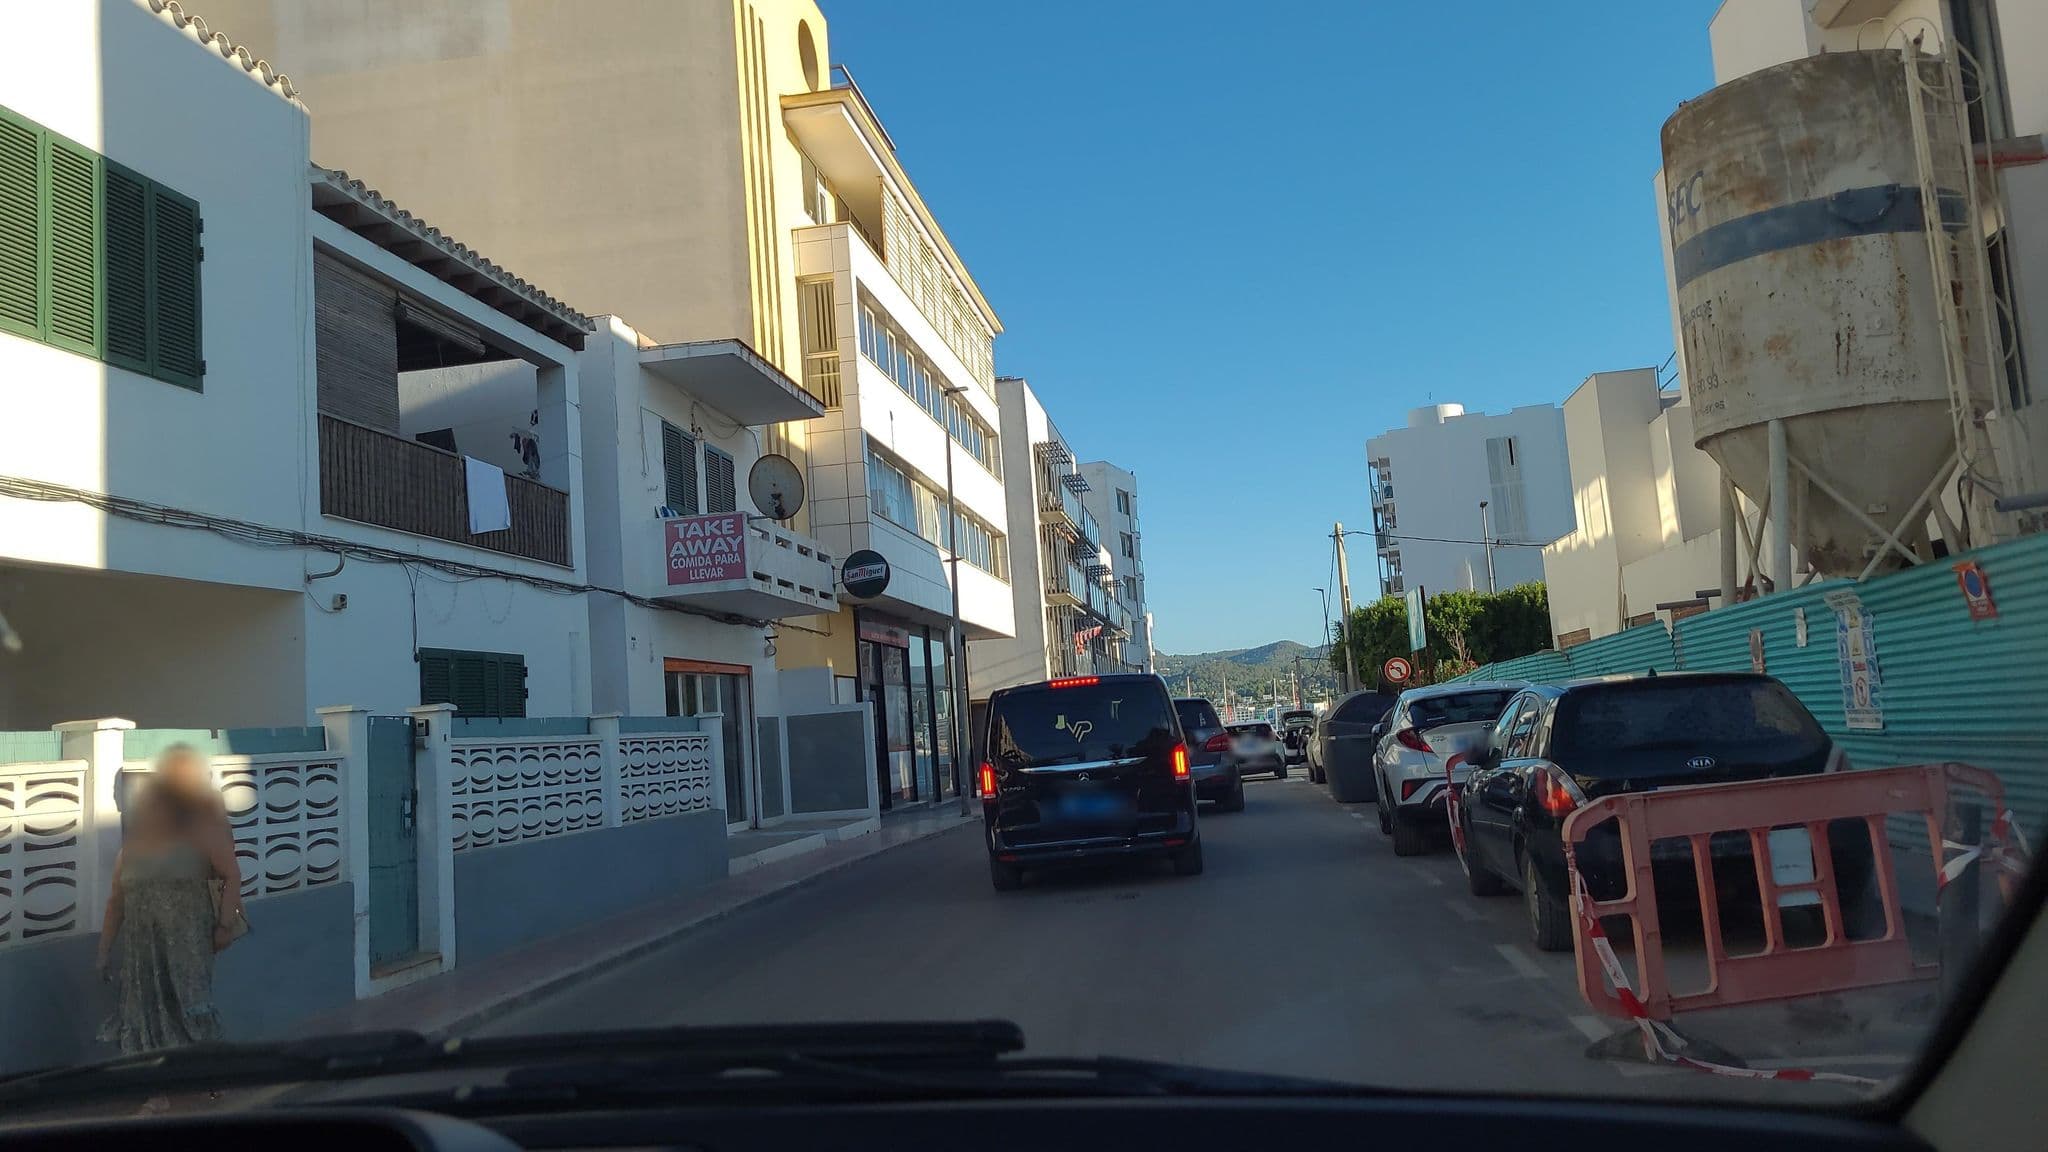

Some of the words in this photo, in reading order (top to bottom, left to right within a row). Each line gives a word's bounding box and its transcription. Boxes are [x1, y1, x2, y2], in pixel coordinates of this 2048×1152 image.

[674, 518, 735, 539] TAKE
[669, 535, 743, 558] AWAY
[671, 556, 713, 569] COMIDA
[714, 553, 741, 565] PARA
[689, 567, 724, 580] LLEVAR
[1692, 754, 1711, 767] KIA
